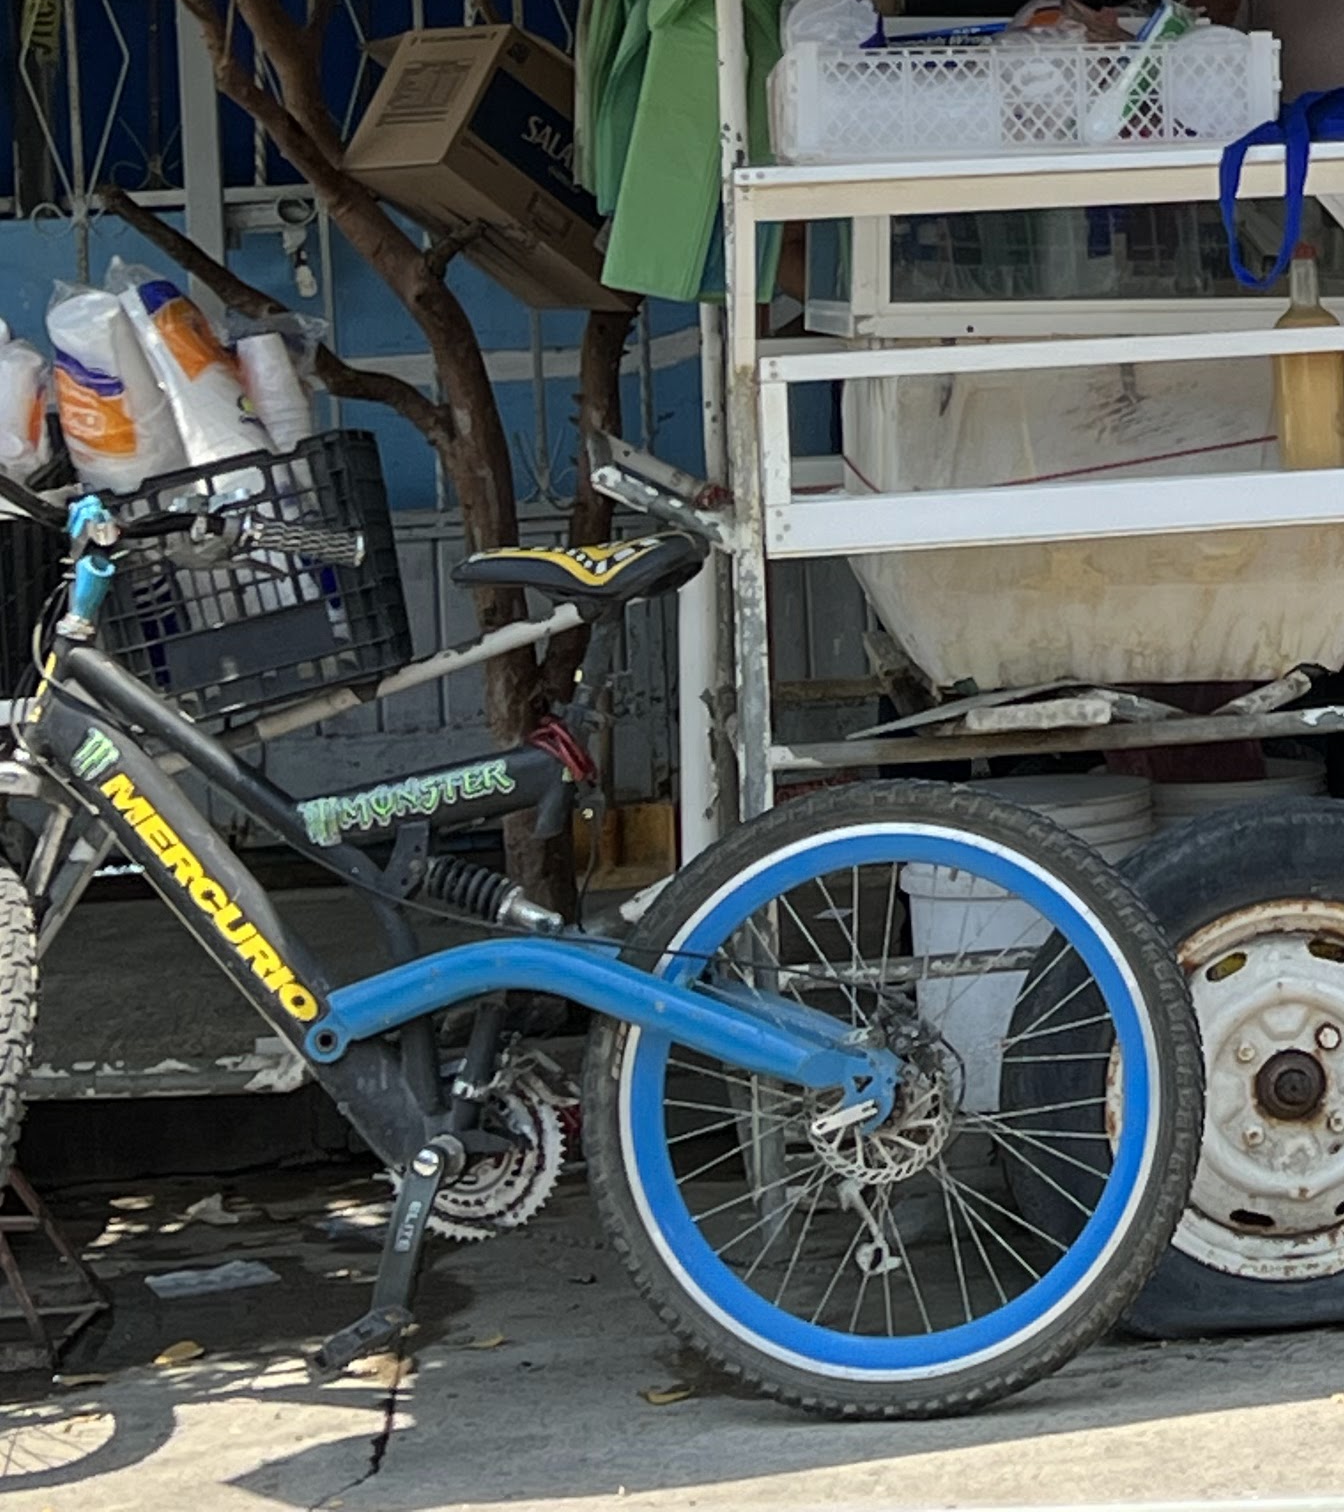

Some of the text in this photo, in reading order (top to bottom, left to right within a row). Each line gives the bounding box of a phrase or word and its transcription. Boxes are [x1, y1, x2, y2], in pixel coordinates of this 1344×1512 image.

[341, 758, 516, 830] MONSTER
[99, 772, 319, 1022] MERCURIO
[394, 1200, 422, 1252] ELITE
